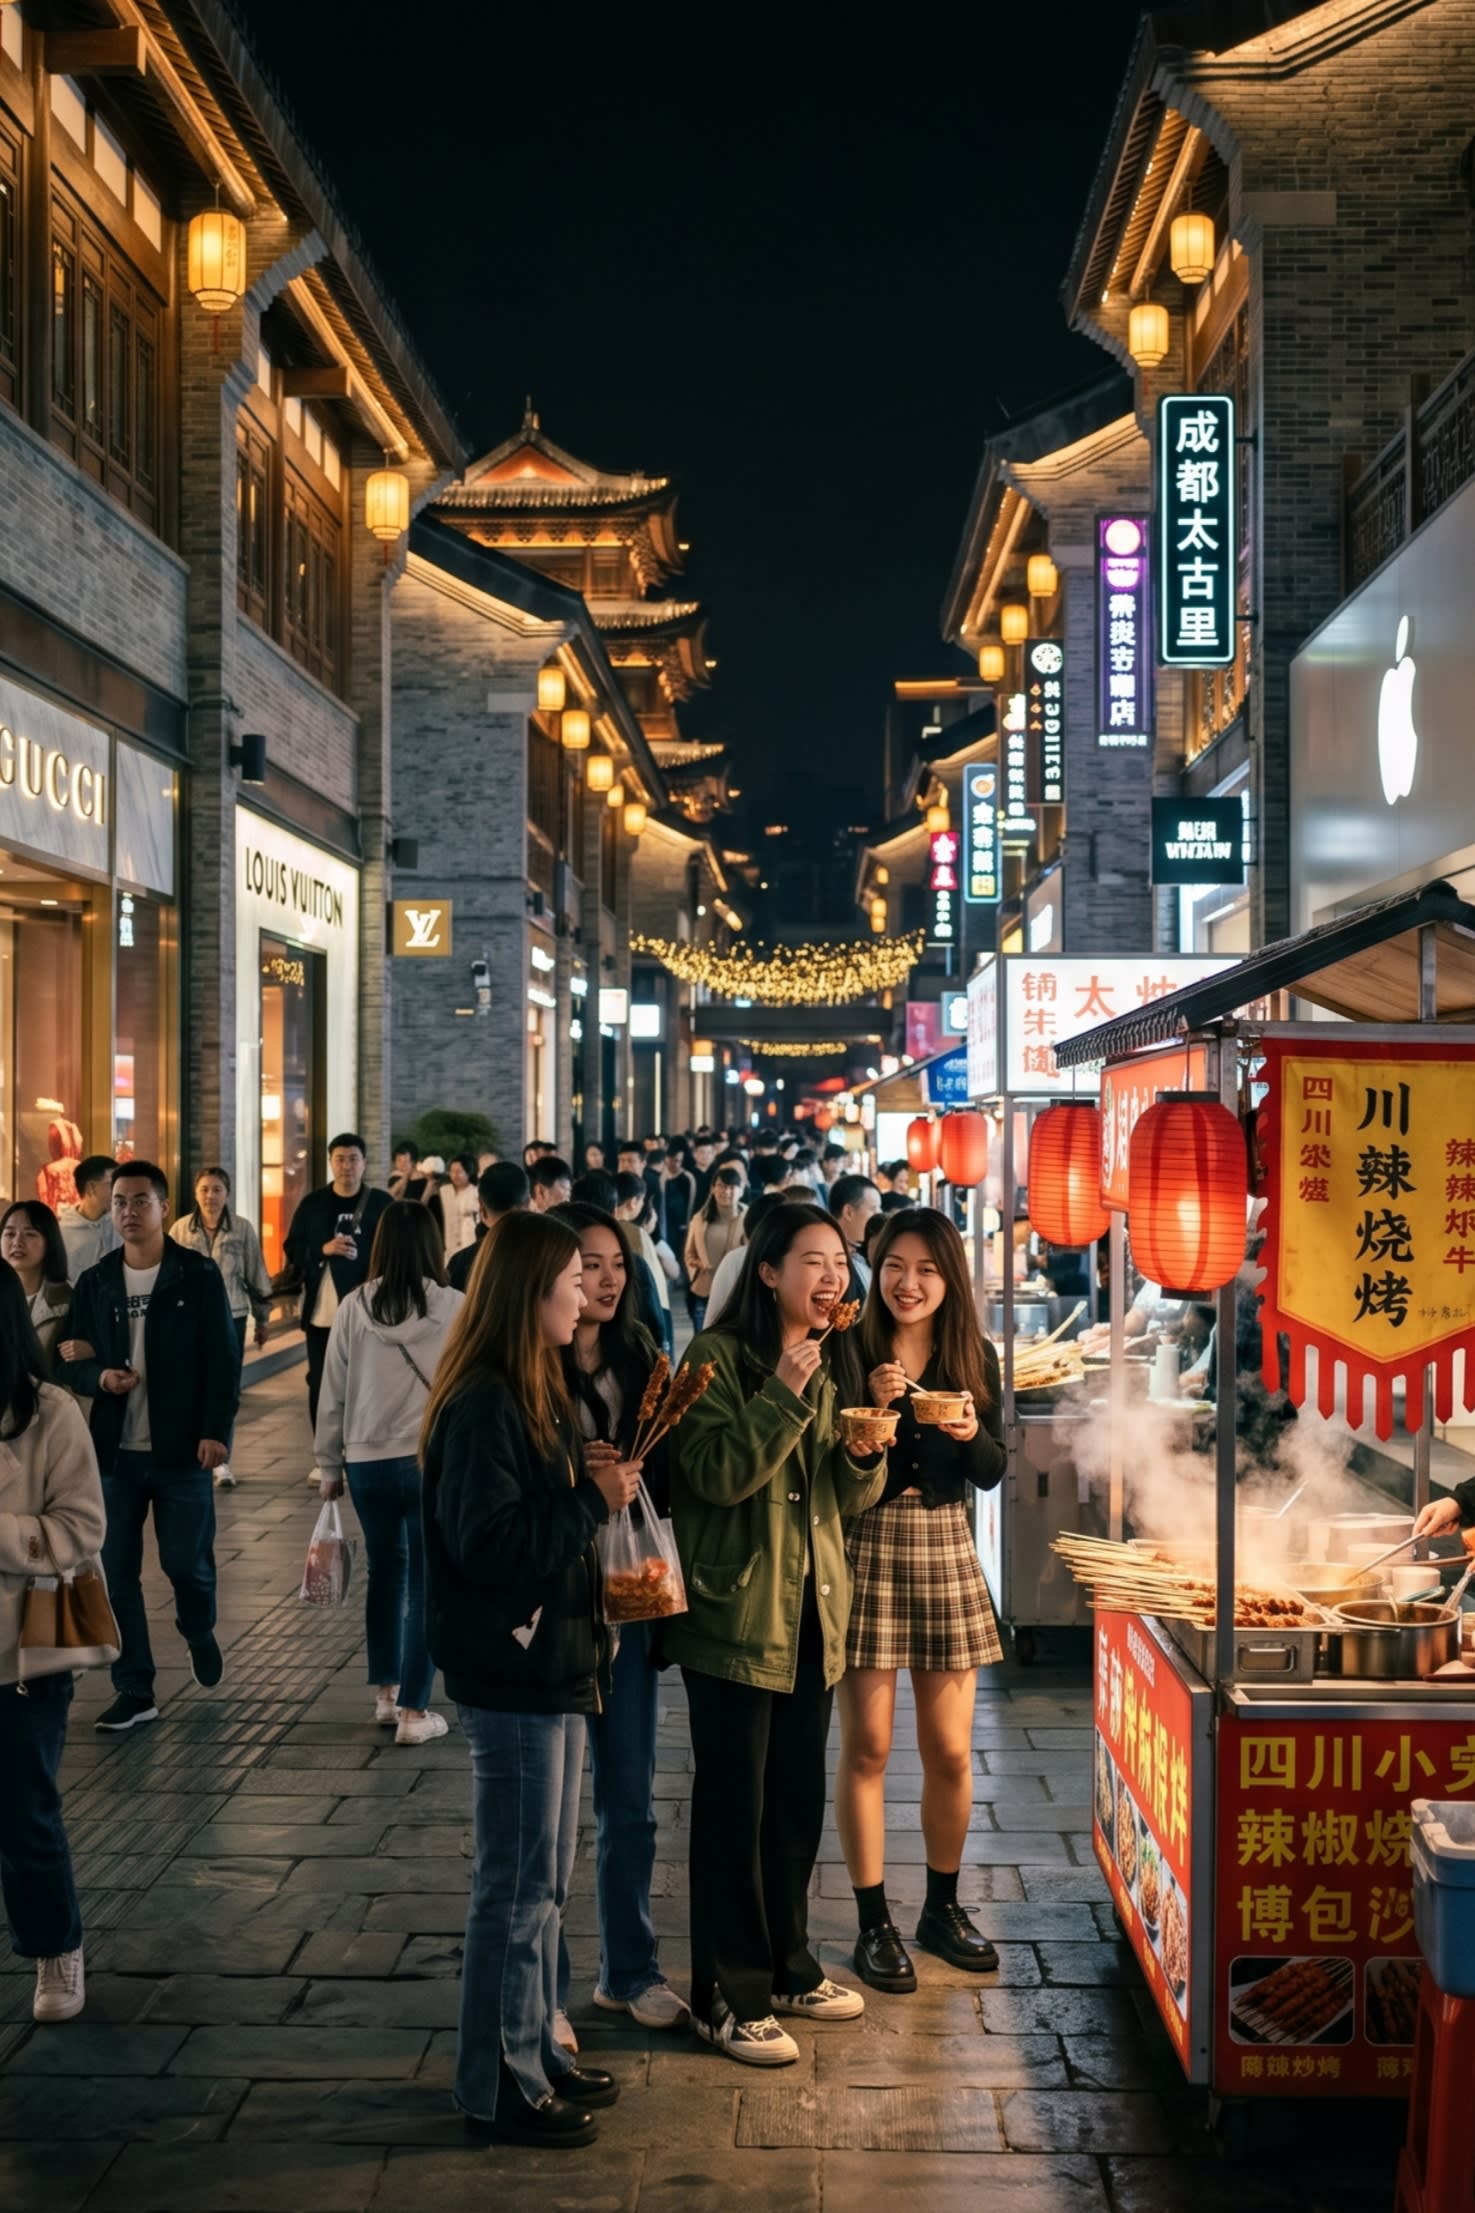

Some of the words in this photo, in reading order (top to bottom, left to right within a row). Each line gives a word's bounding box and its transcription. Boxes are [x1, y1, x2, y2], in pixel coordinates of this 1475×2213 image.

[1176, 410, 1219, 646] 成都太古里
[0, 724, 105, 825] GUCCI
[246, 848, 287, 905] LOUIS
[291, 868, 343, 928] VUITTON
[1353, 1082, 1416, 1328] 川辣烧烤
